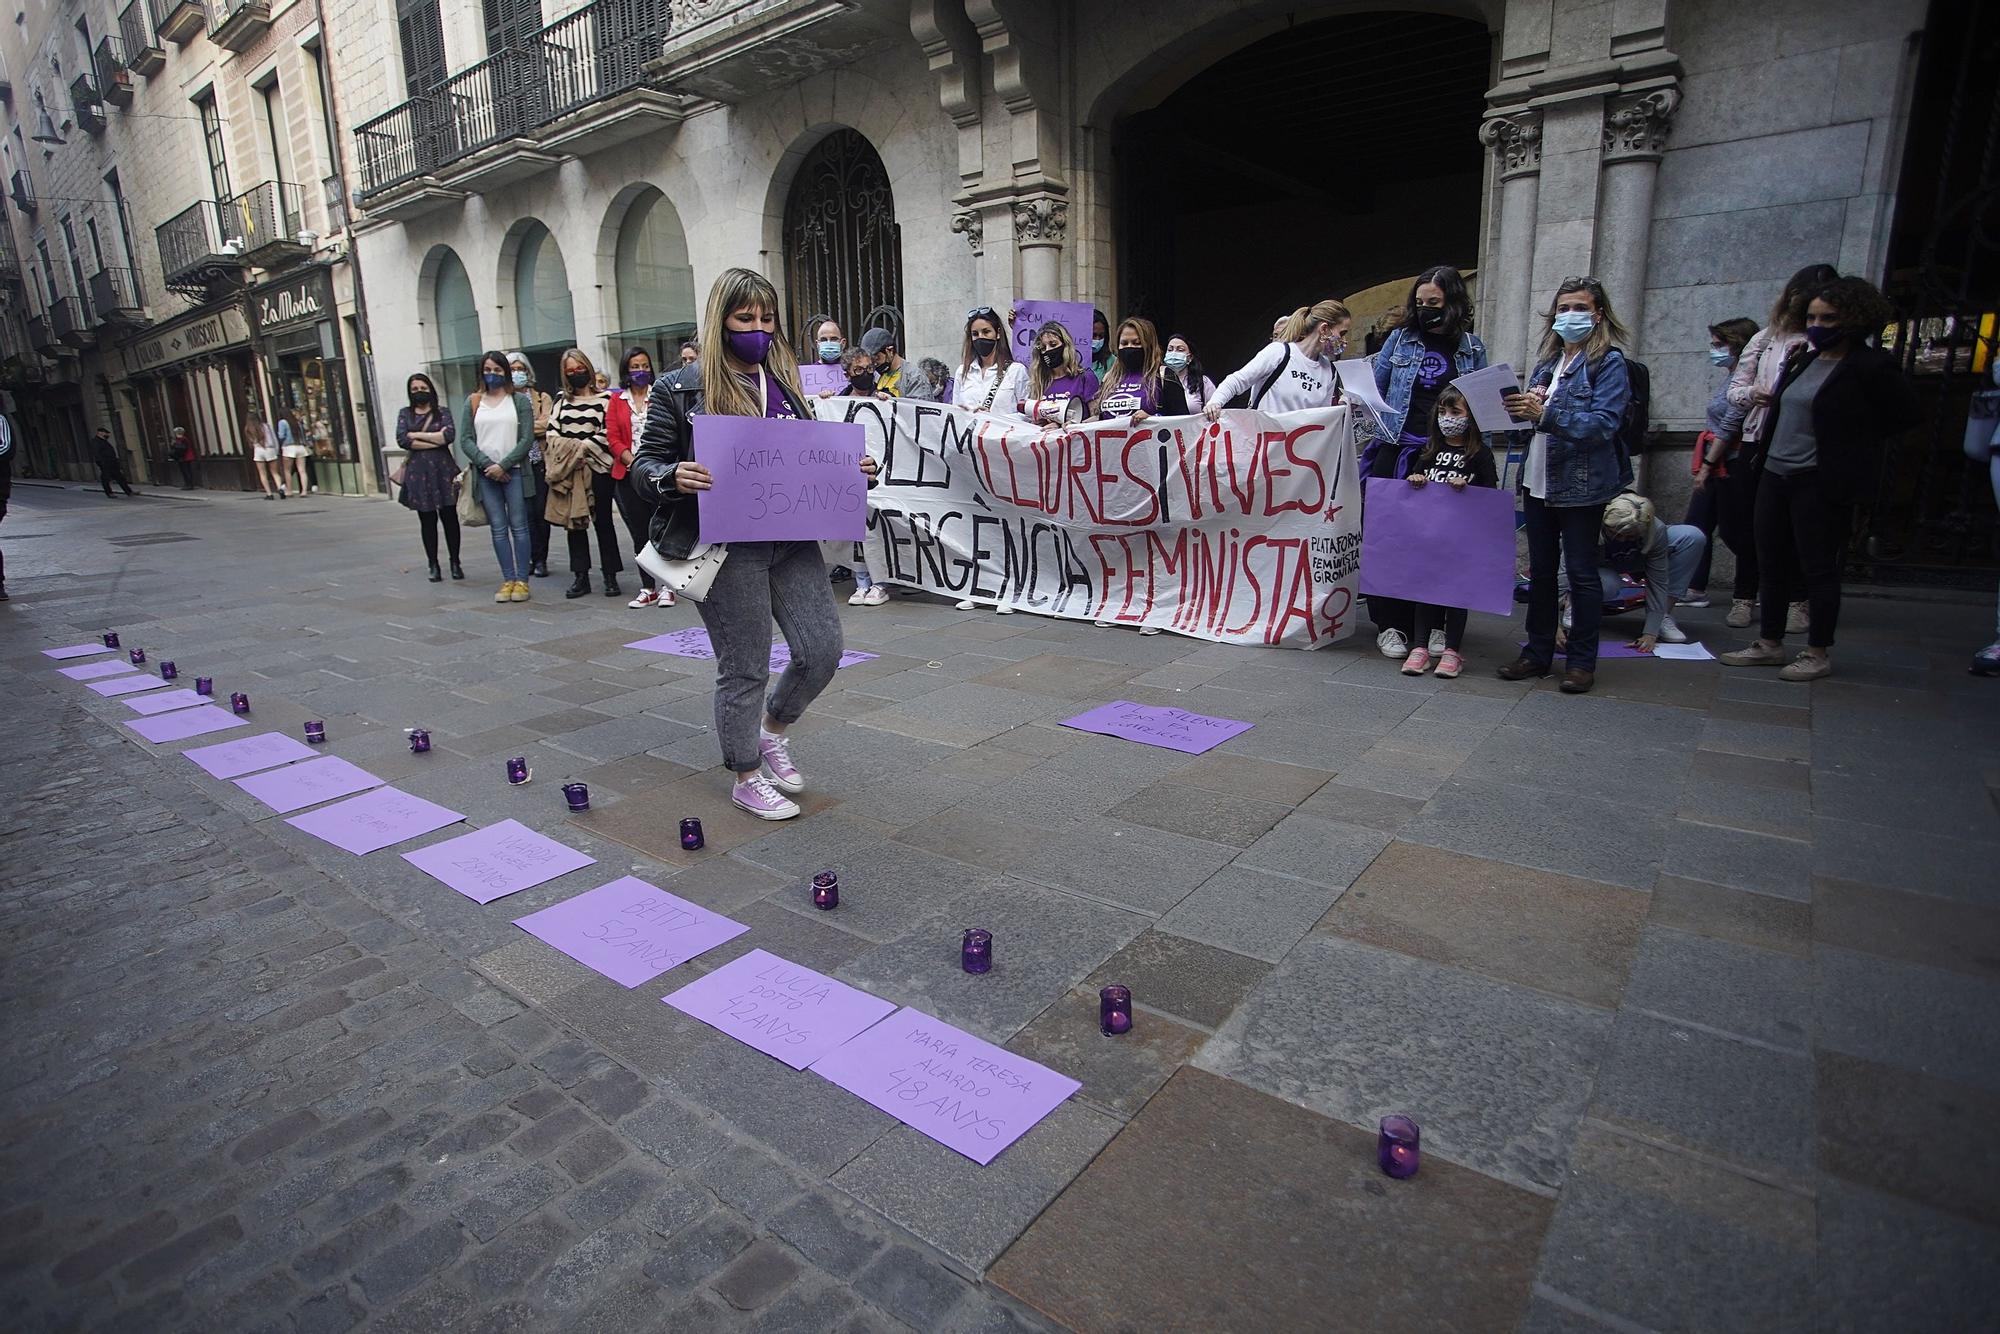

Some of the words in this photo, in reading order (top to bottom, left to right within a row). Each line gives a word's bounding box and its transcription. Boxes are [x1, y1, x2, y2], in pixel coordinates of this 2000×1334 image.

[261, 298, 280, 326] La
[279, 285, 321, 321] Moda
[1018, 307, 1043, 324] SOM
[1052, 312, 1071, 323] EL
[805, 372, 823, 387] EL
[1301, 381, 1313, 392] 61
[734, 448, 785, 475] KATIA
[1311, 530, 1363, 554] PLATAFORMA
[621, 898, 705, 932] BETTY
[749, 984, 804, 1010] DOTTO
[755, 964, 833, 1006] LUCÍA
[905, 1029, 959, 1059] MARÍA
[966, 1056, 1032, 1094] TERESA
[913, 1058, 991, 1097] ALARDO
